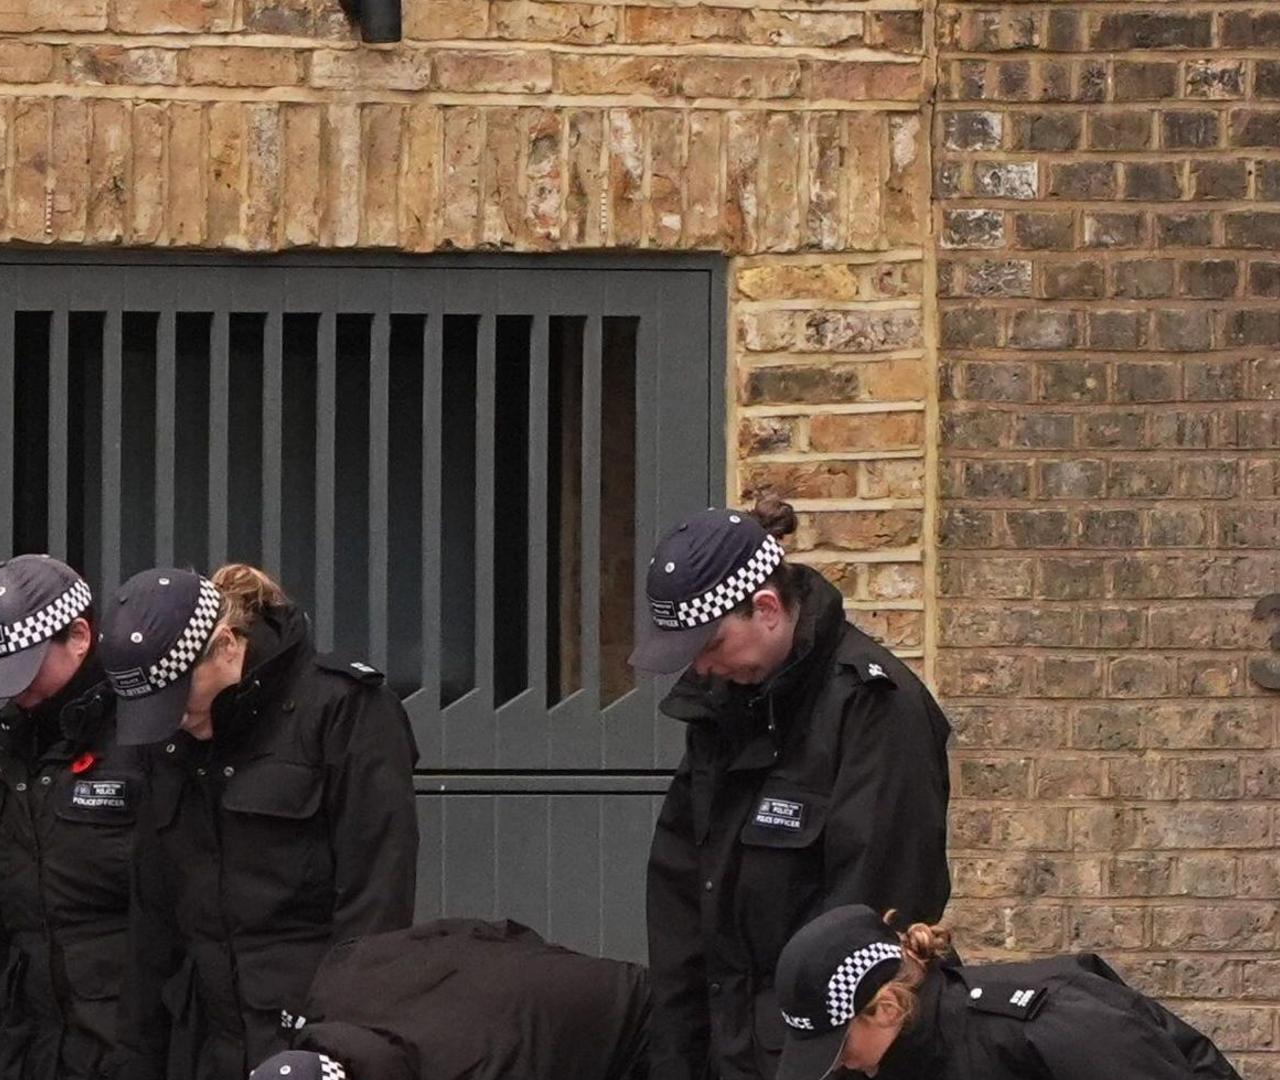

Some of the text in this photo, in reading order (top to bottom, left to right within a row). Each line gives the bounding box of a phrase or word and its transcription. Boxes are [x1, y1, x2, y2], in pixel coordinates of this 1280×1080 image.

[95, 788, 116, 796] POLICE
[73, 796, 125, 807] POLICE OFFICER
[773, 806, 794, 816] POLICE
[756, 814, 801, 829] POLICE OFFICER
